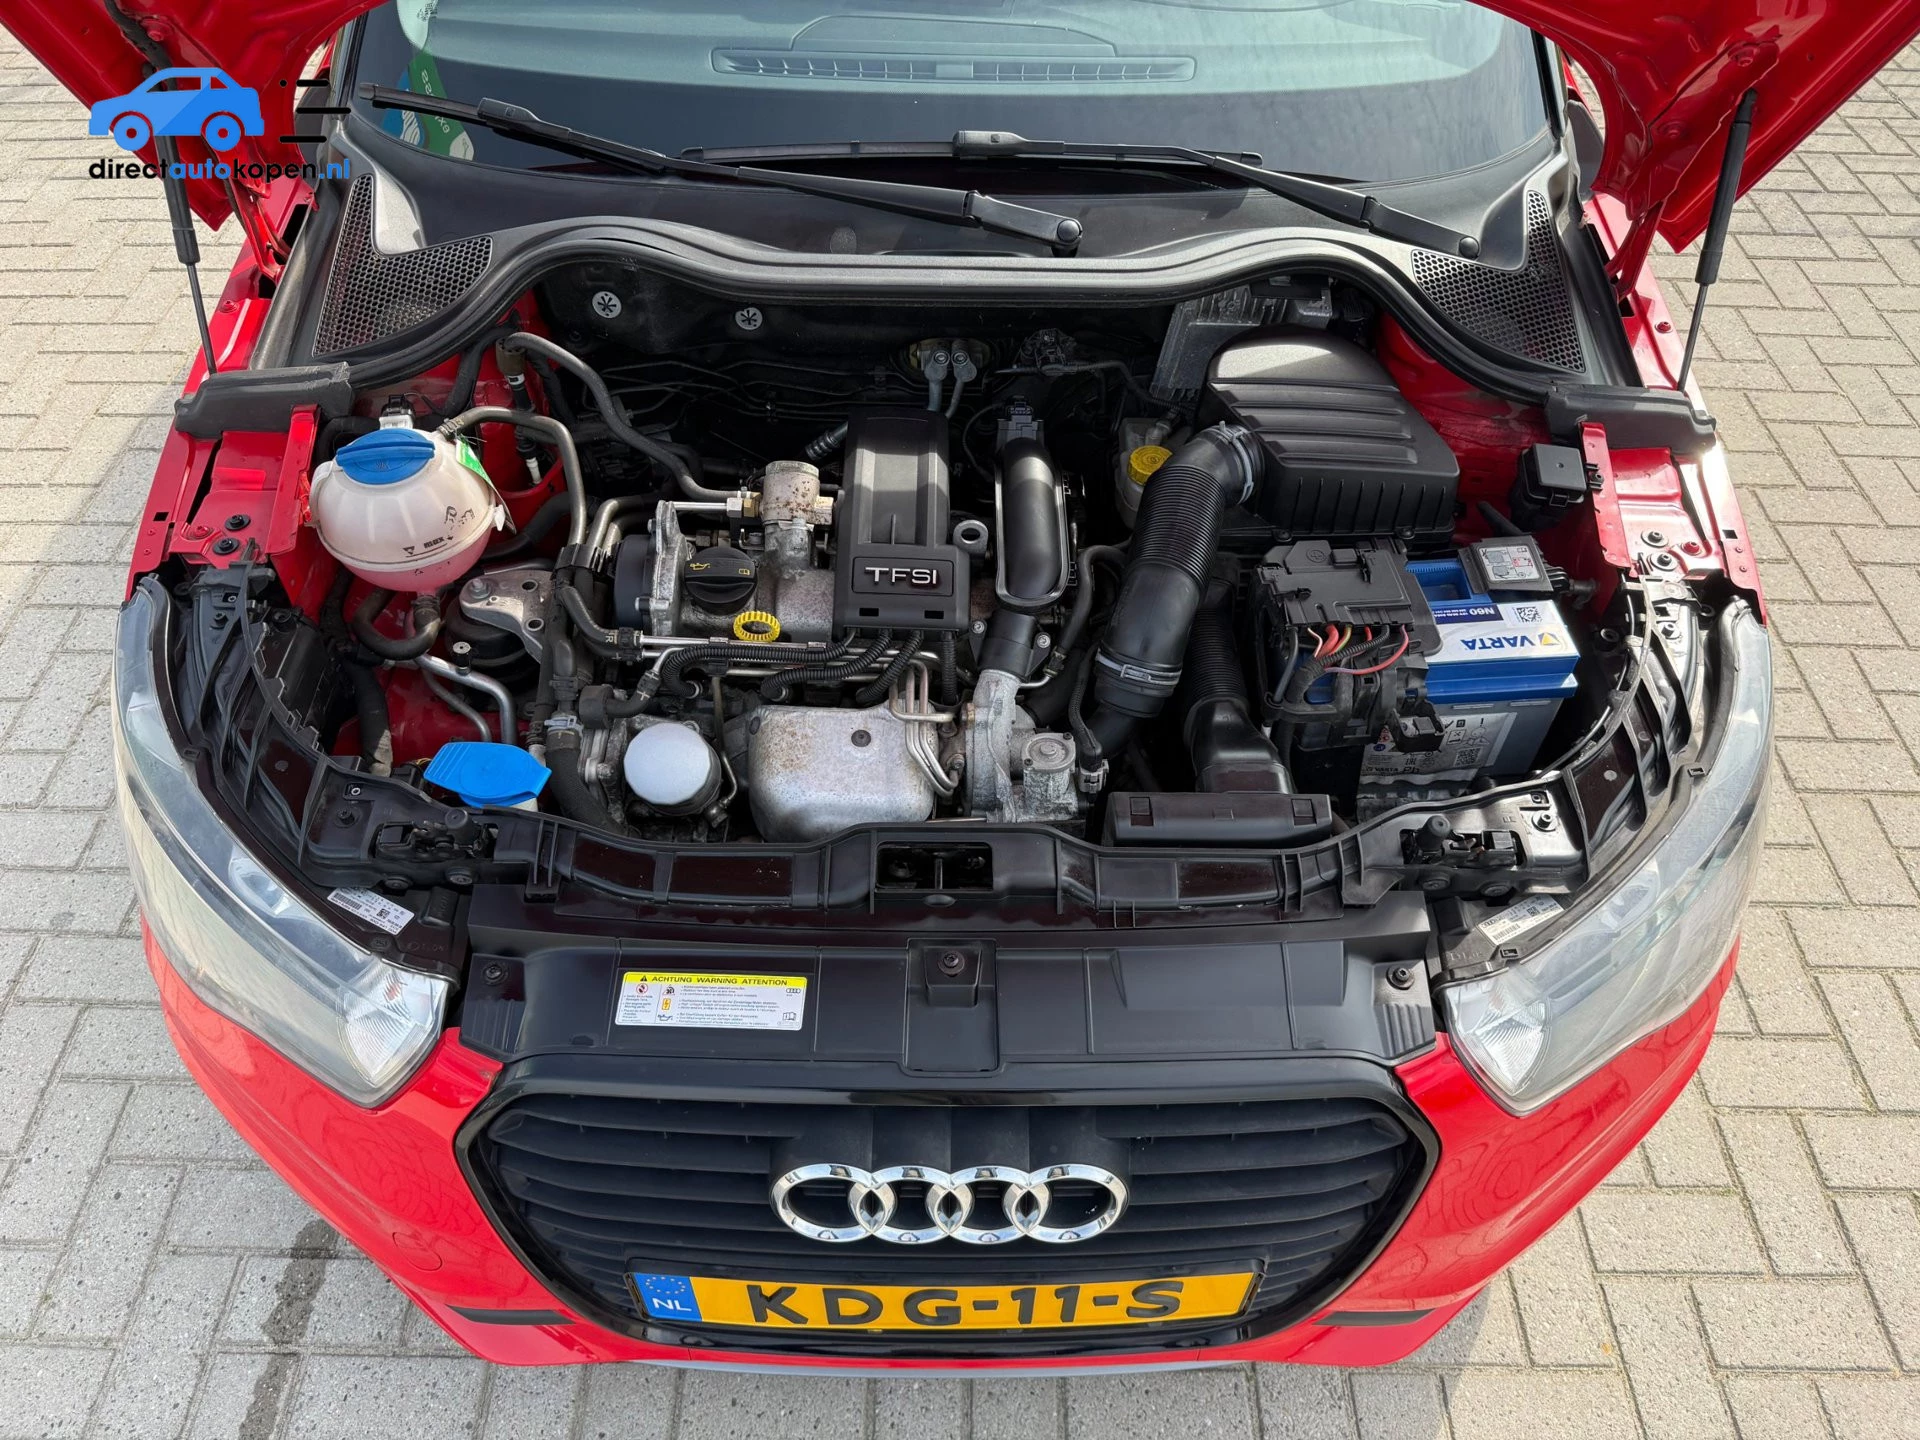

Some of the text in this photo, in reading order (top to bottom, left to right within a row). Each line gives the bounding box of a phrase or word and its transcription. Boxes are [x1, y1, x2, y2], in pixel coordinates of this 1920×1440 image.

[865, 567, 938, 584] TFSI
[1469, 607, 1495, 616] N60
[1461, 636, 1535, 650] VARTA
[651, 976, 788, 986] ACHTUNG WARNING ATTENTION
[651, 1297, 692, 1313] NL
[745, 1280, 1184, 1325] KDG-11-S
